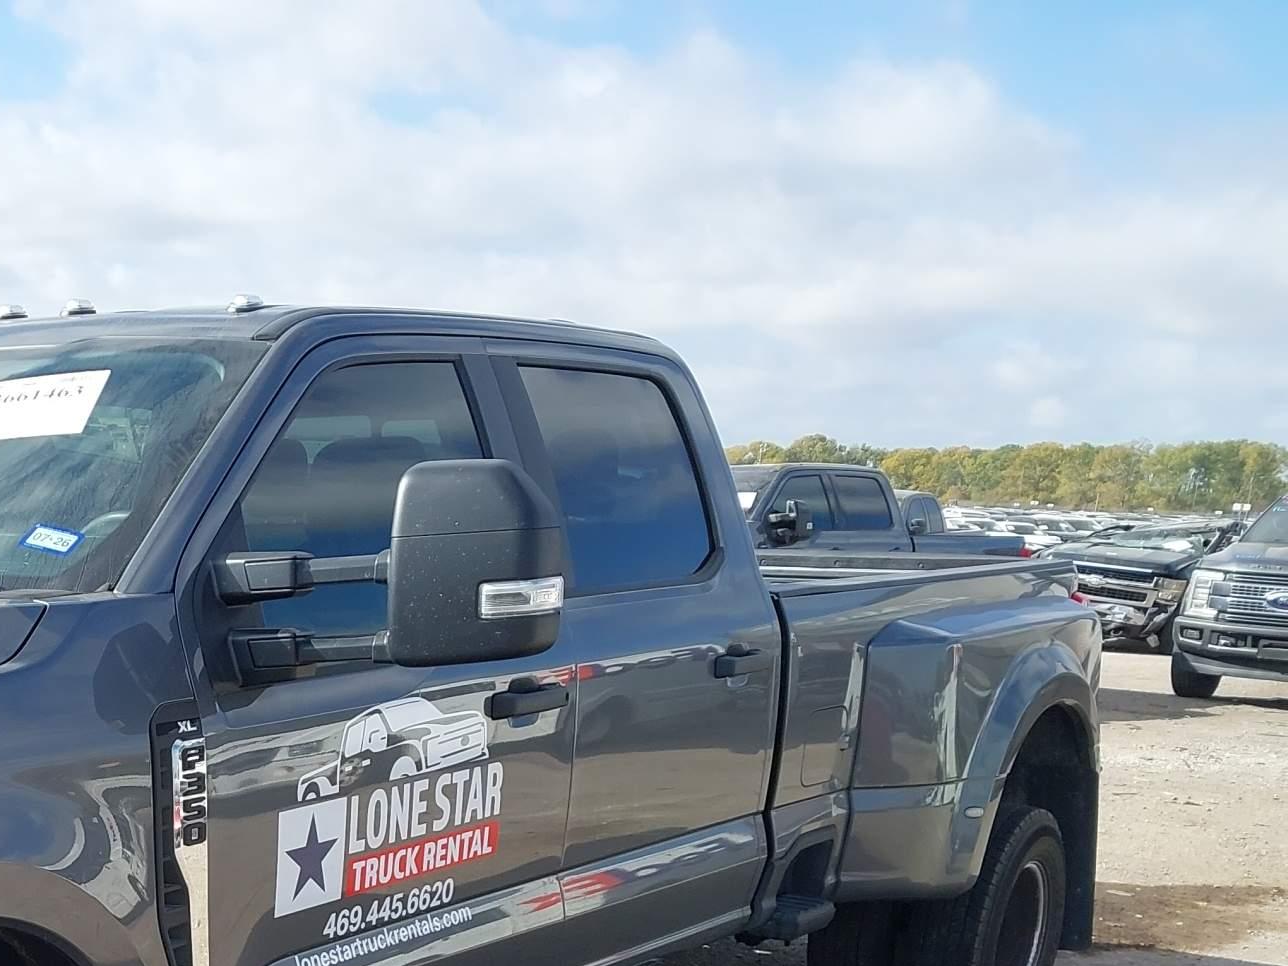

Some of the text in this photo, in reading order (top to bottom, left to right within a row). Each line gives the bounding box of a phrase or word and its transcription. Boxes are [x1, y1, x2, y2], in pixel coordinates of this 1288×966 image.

[177, 720, 197, 733] XL
[348, 761, 504, 855] LONE STAR
[352, 826, 493, 892] TRUCK RENTAL
[322, 878, 455, 939] 469.445.6620
